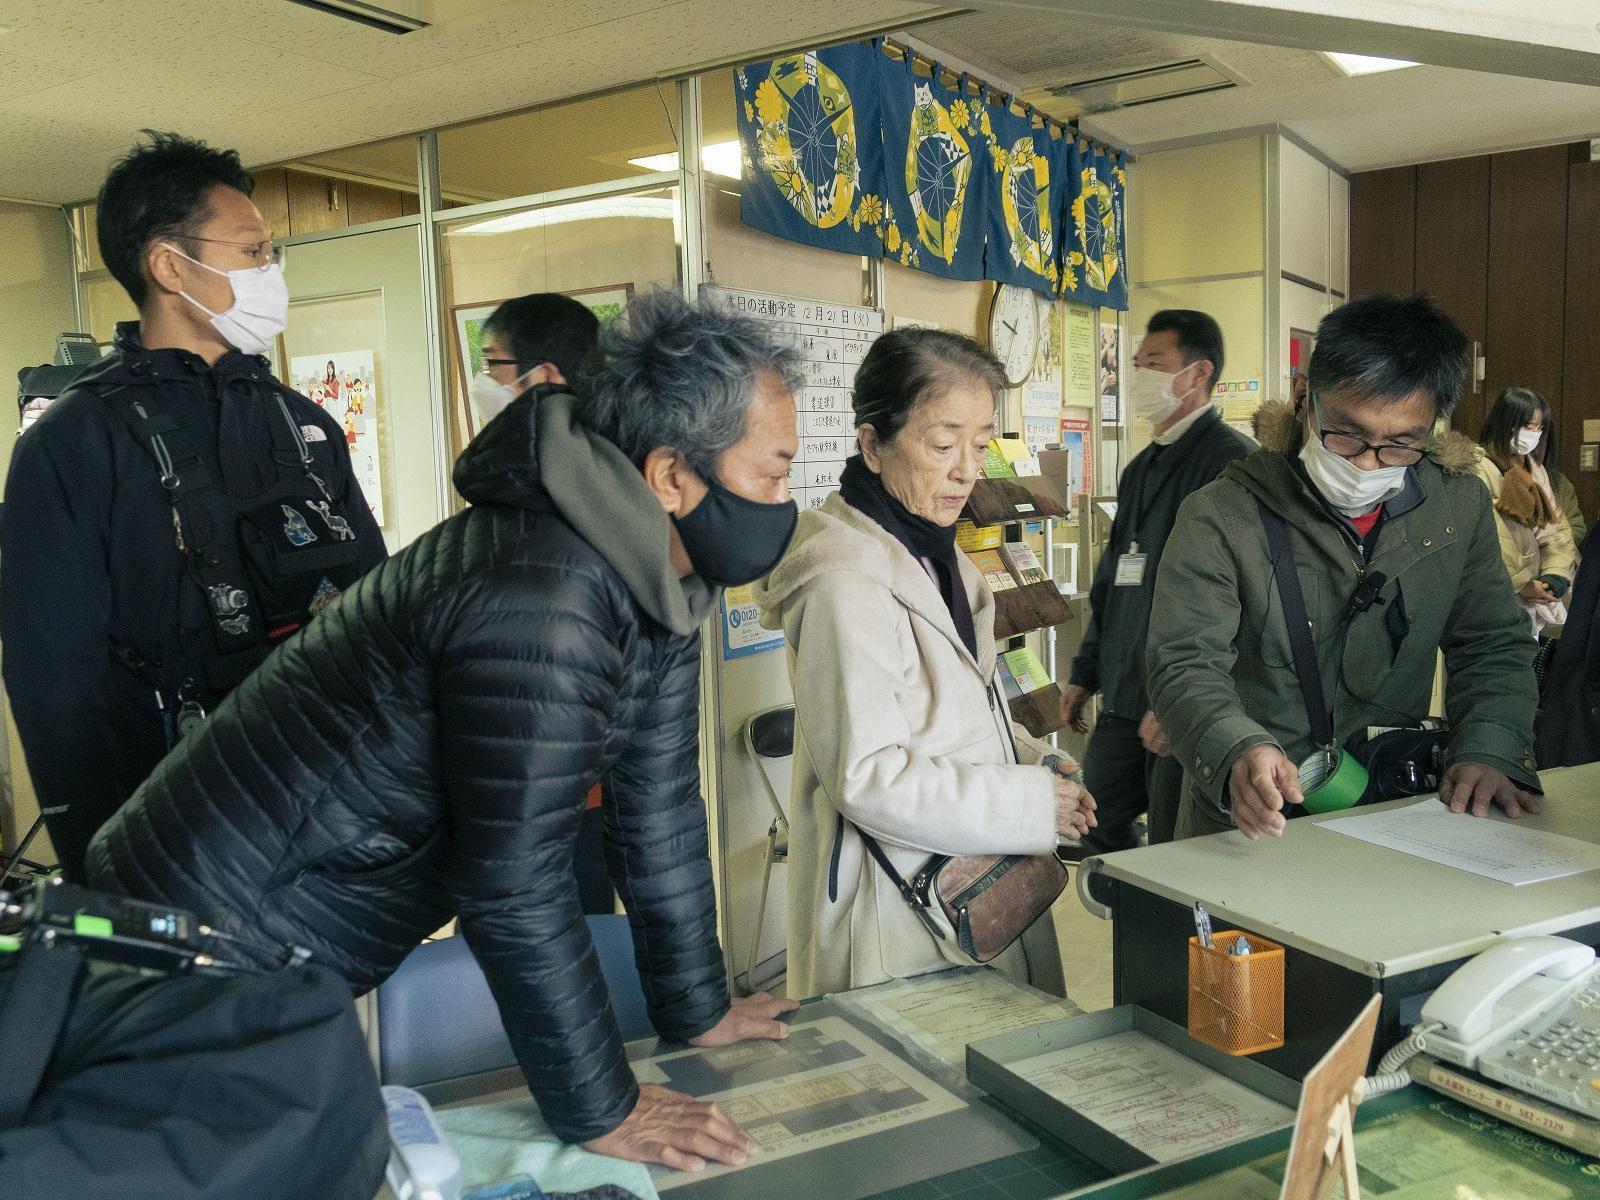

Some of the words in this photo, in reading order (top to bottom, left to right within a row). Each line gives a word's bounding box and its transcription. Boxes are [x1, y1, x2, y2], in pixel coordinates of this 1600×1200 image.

[727, 293, 796, 318] 本日の活動予定
